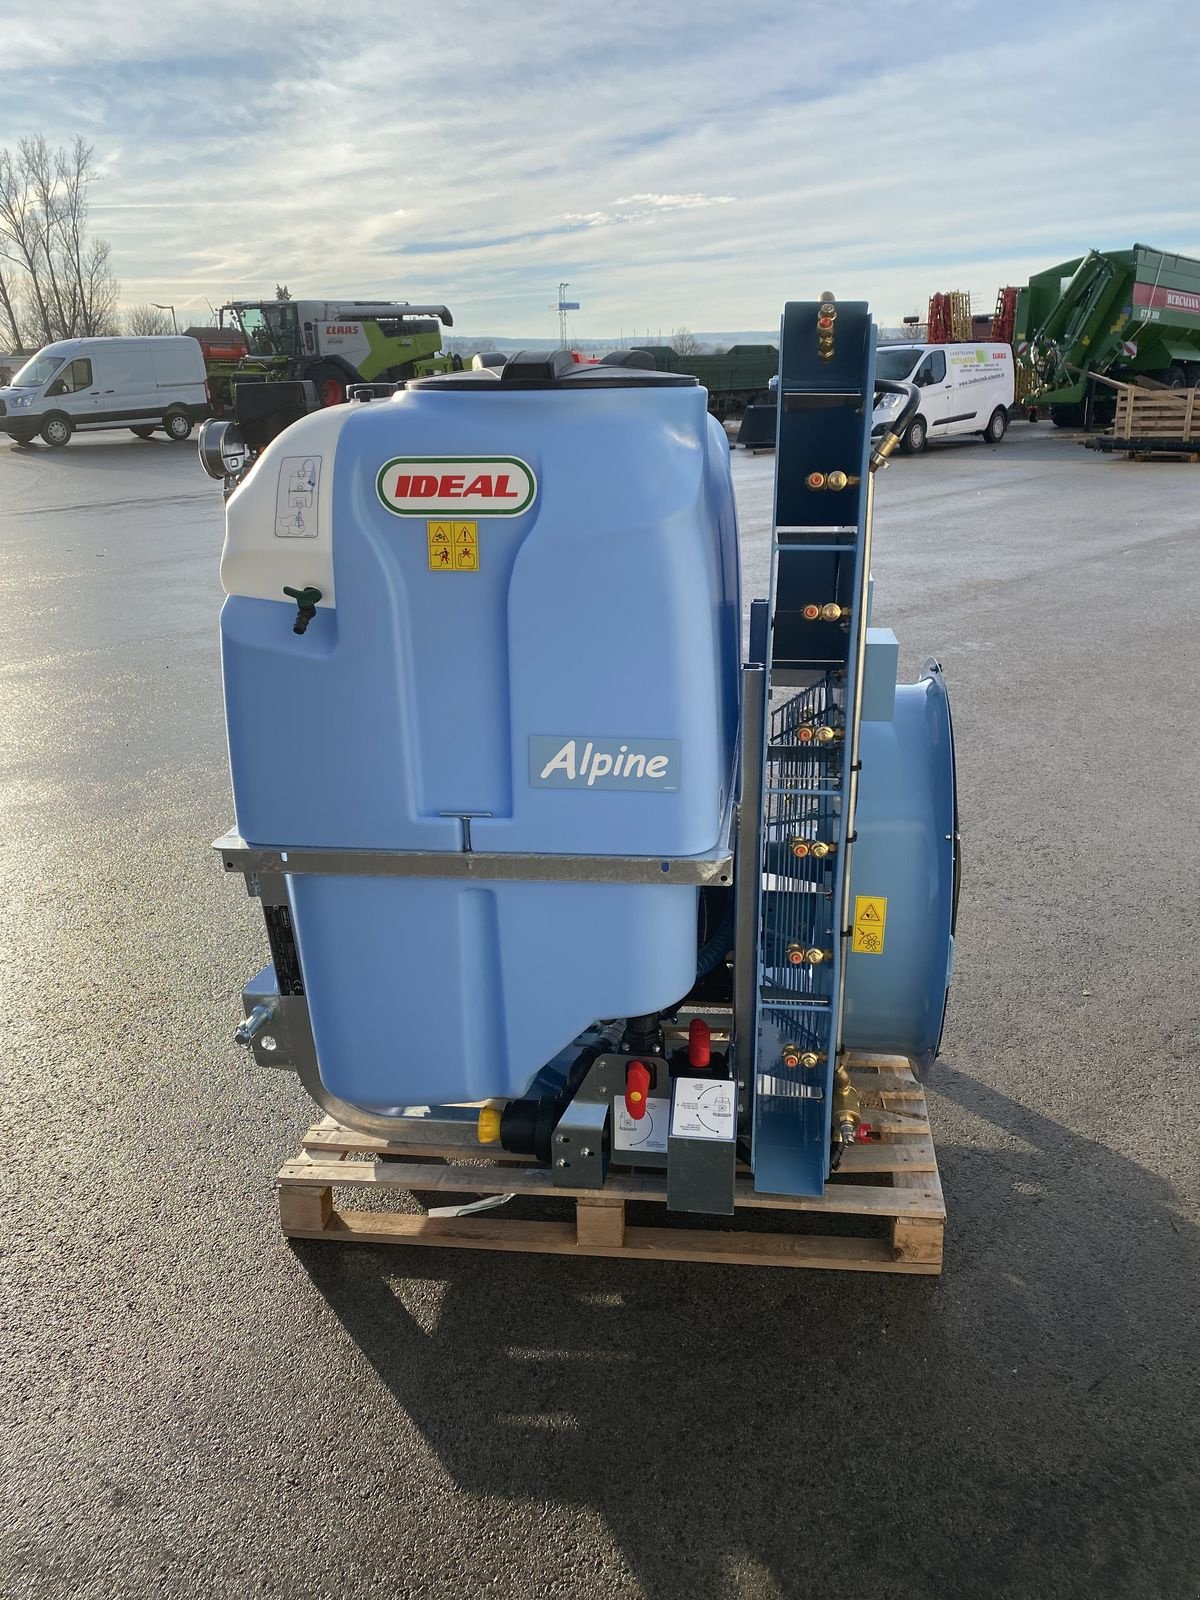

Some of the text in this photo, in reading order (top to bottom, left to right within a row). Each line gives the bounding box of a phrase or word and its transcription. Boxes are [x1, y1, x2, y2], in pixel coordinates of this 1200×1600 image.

[1167, 294, 1199, 308] BERGMANN
[326, 326, 359, 335] CLAAS
[395, 475, 519, 498] IDEAL
[540, 740, 669, 786] Alpine
